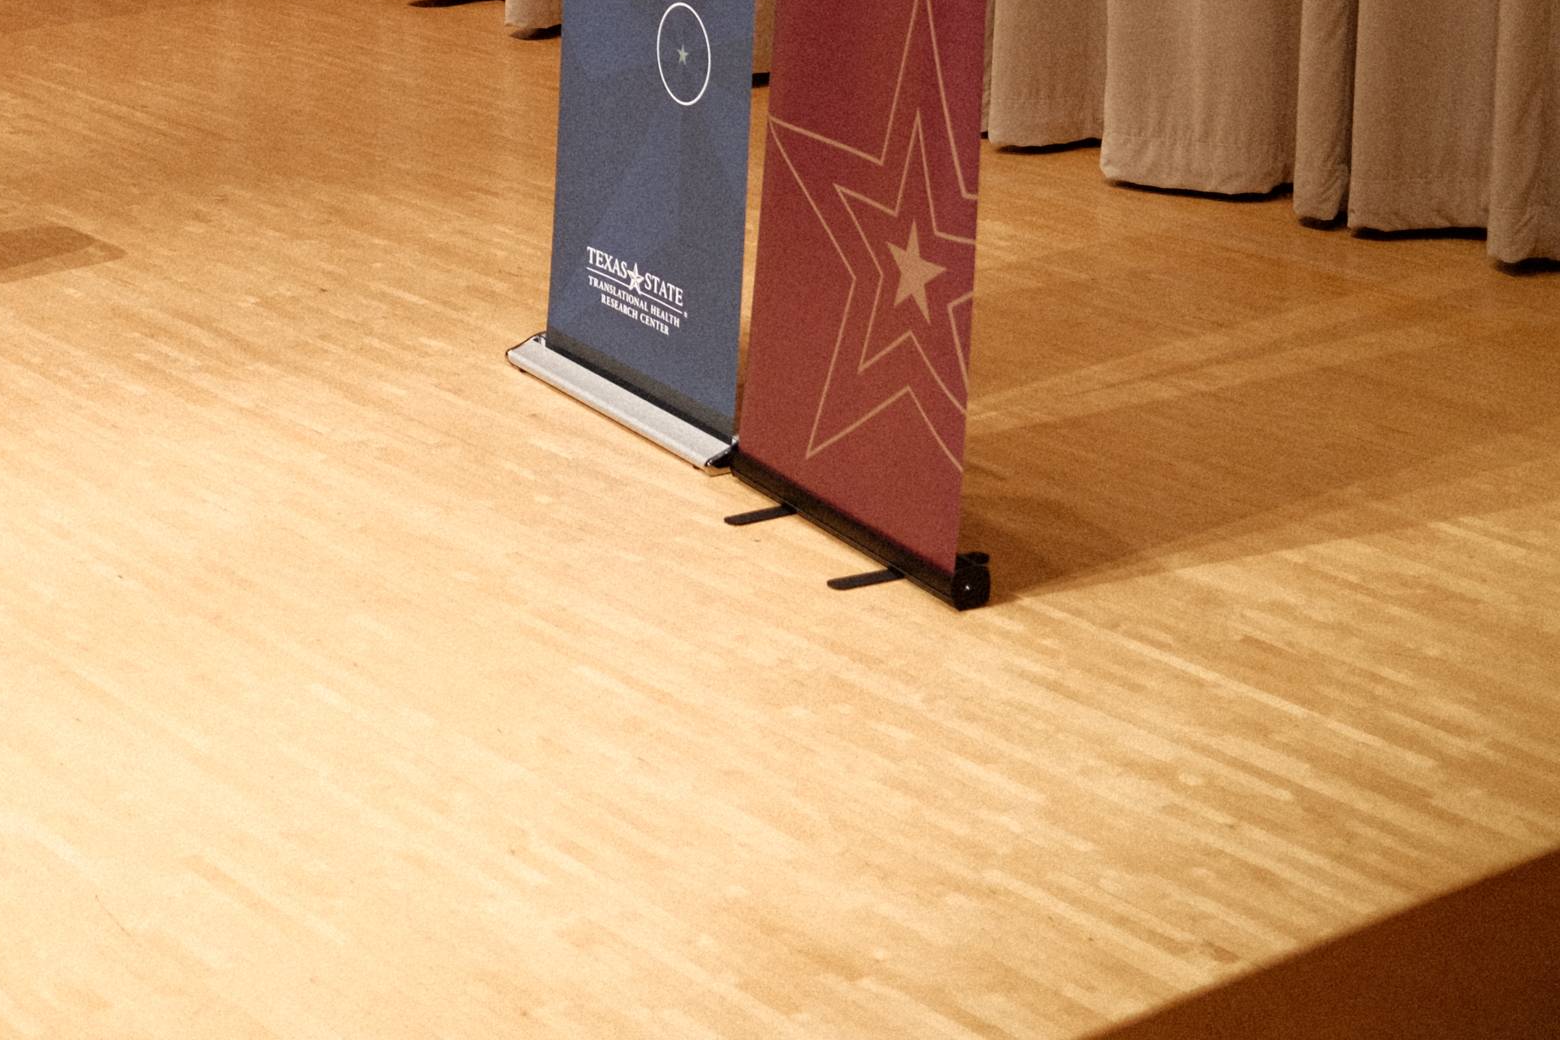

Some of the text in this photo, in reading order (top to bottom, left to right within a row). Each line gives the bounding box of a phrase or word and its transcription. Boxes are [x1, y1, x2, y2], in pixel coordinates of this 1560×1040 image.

[586, 246, 684, 307] TEXAS STATE
[588, 275, 680, 328] TRANSLATIONAL HEALTH
[601, 293, 670, 336] RESEARCH CENTER
